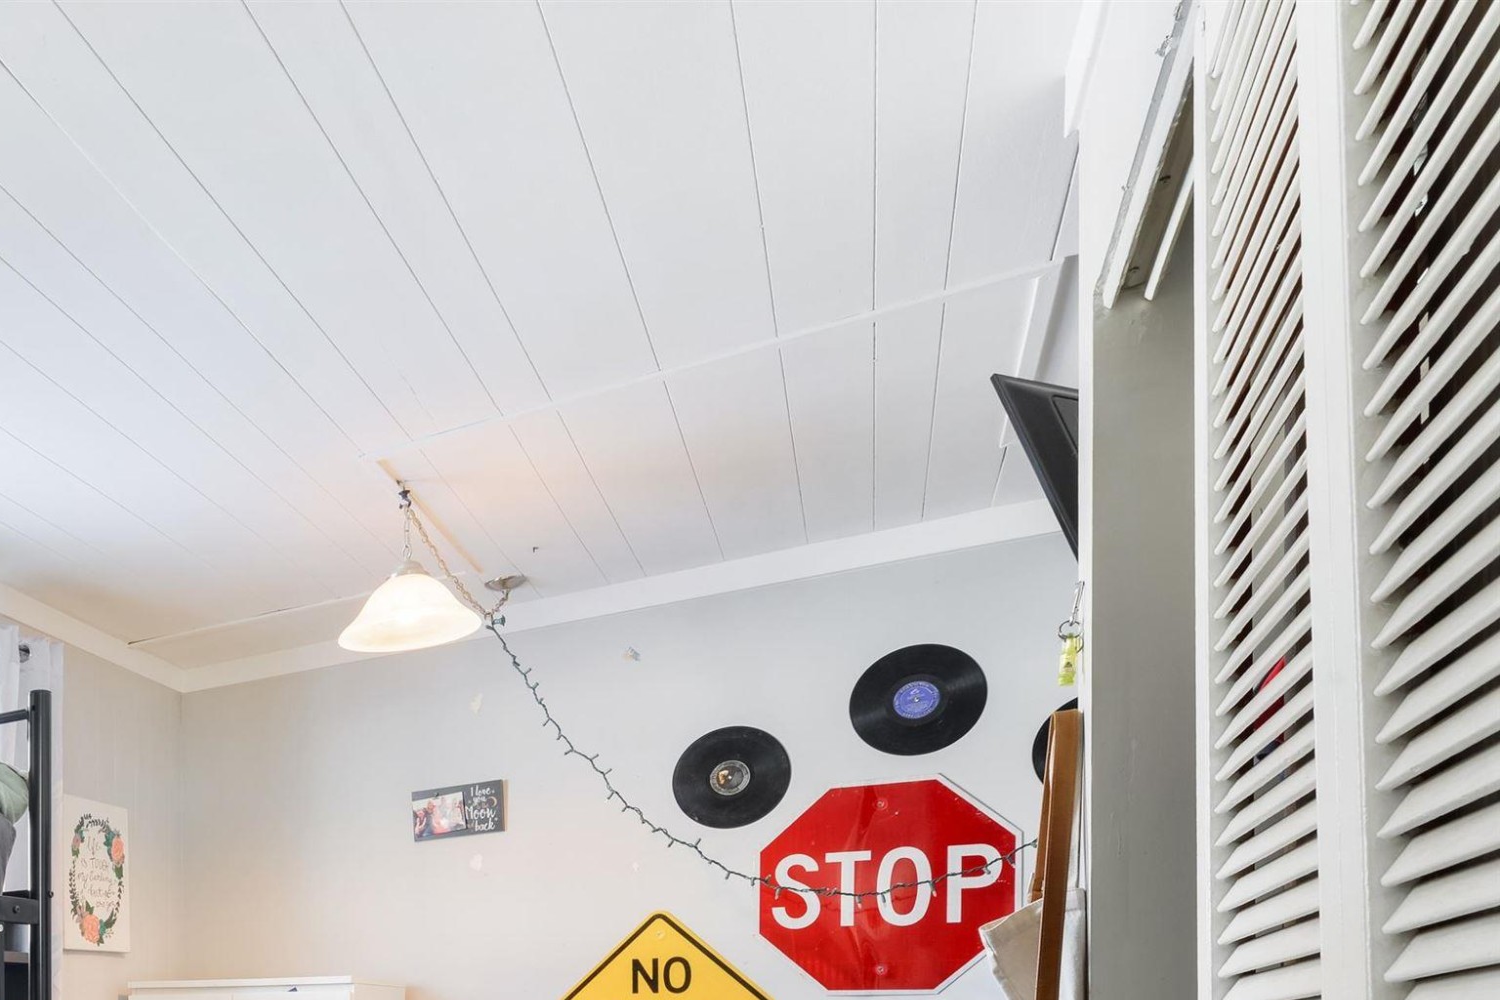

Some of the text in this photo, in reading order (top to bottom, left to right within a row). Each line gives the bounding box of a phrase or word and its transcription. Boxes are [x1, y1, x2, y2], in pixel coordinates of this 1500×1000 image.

[475, 785, 490, 797] love
[465, 805, 496, 820] Moon
[475, 817, 496, 831] back
[772, 843, 1003, 929] STOP
[632, 956, 692, 994] NO
